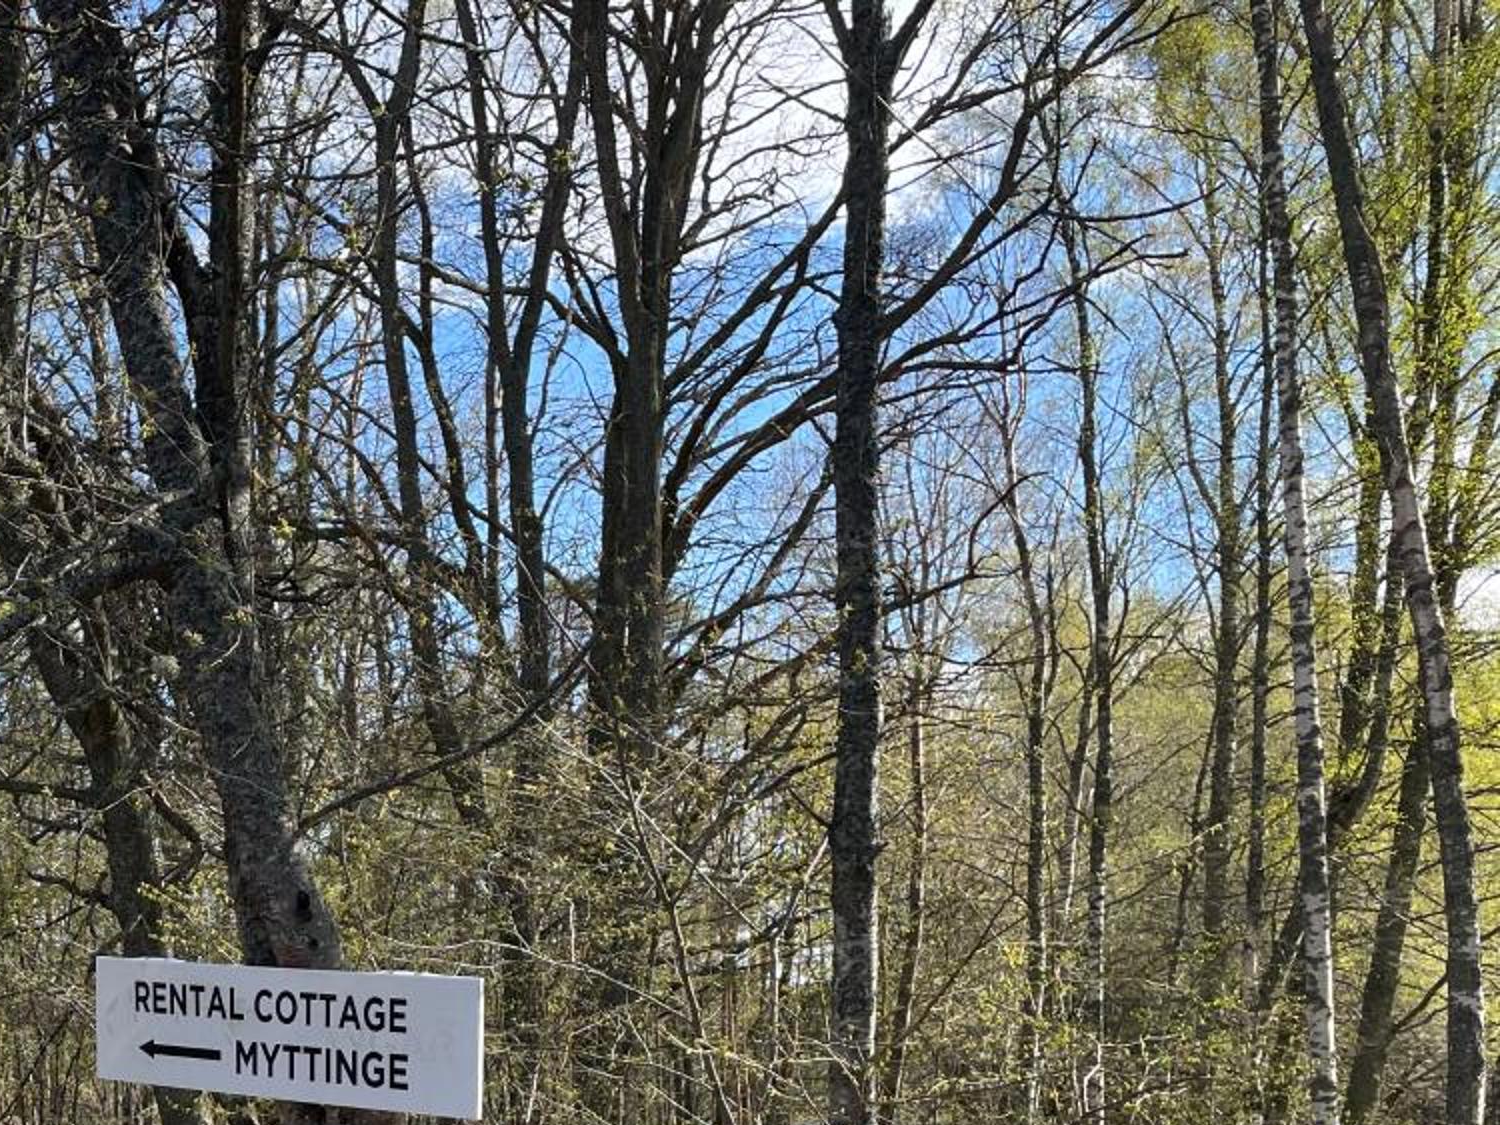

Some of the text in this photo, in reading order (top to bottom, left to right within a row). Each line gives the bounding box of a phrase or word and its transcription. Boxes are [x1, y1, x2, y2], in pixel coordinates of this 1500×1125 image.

[134, 981, 408, 1034] RENTAL COTTAGE
[235, 1041, 409, 1090] MYTTINGE
